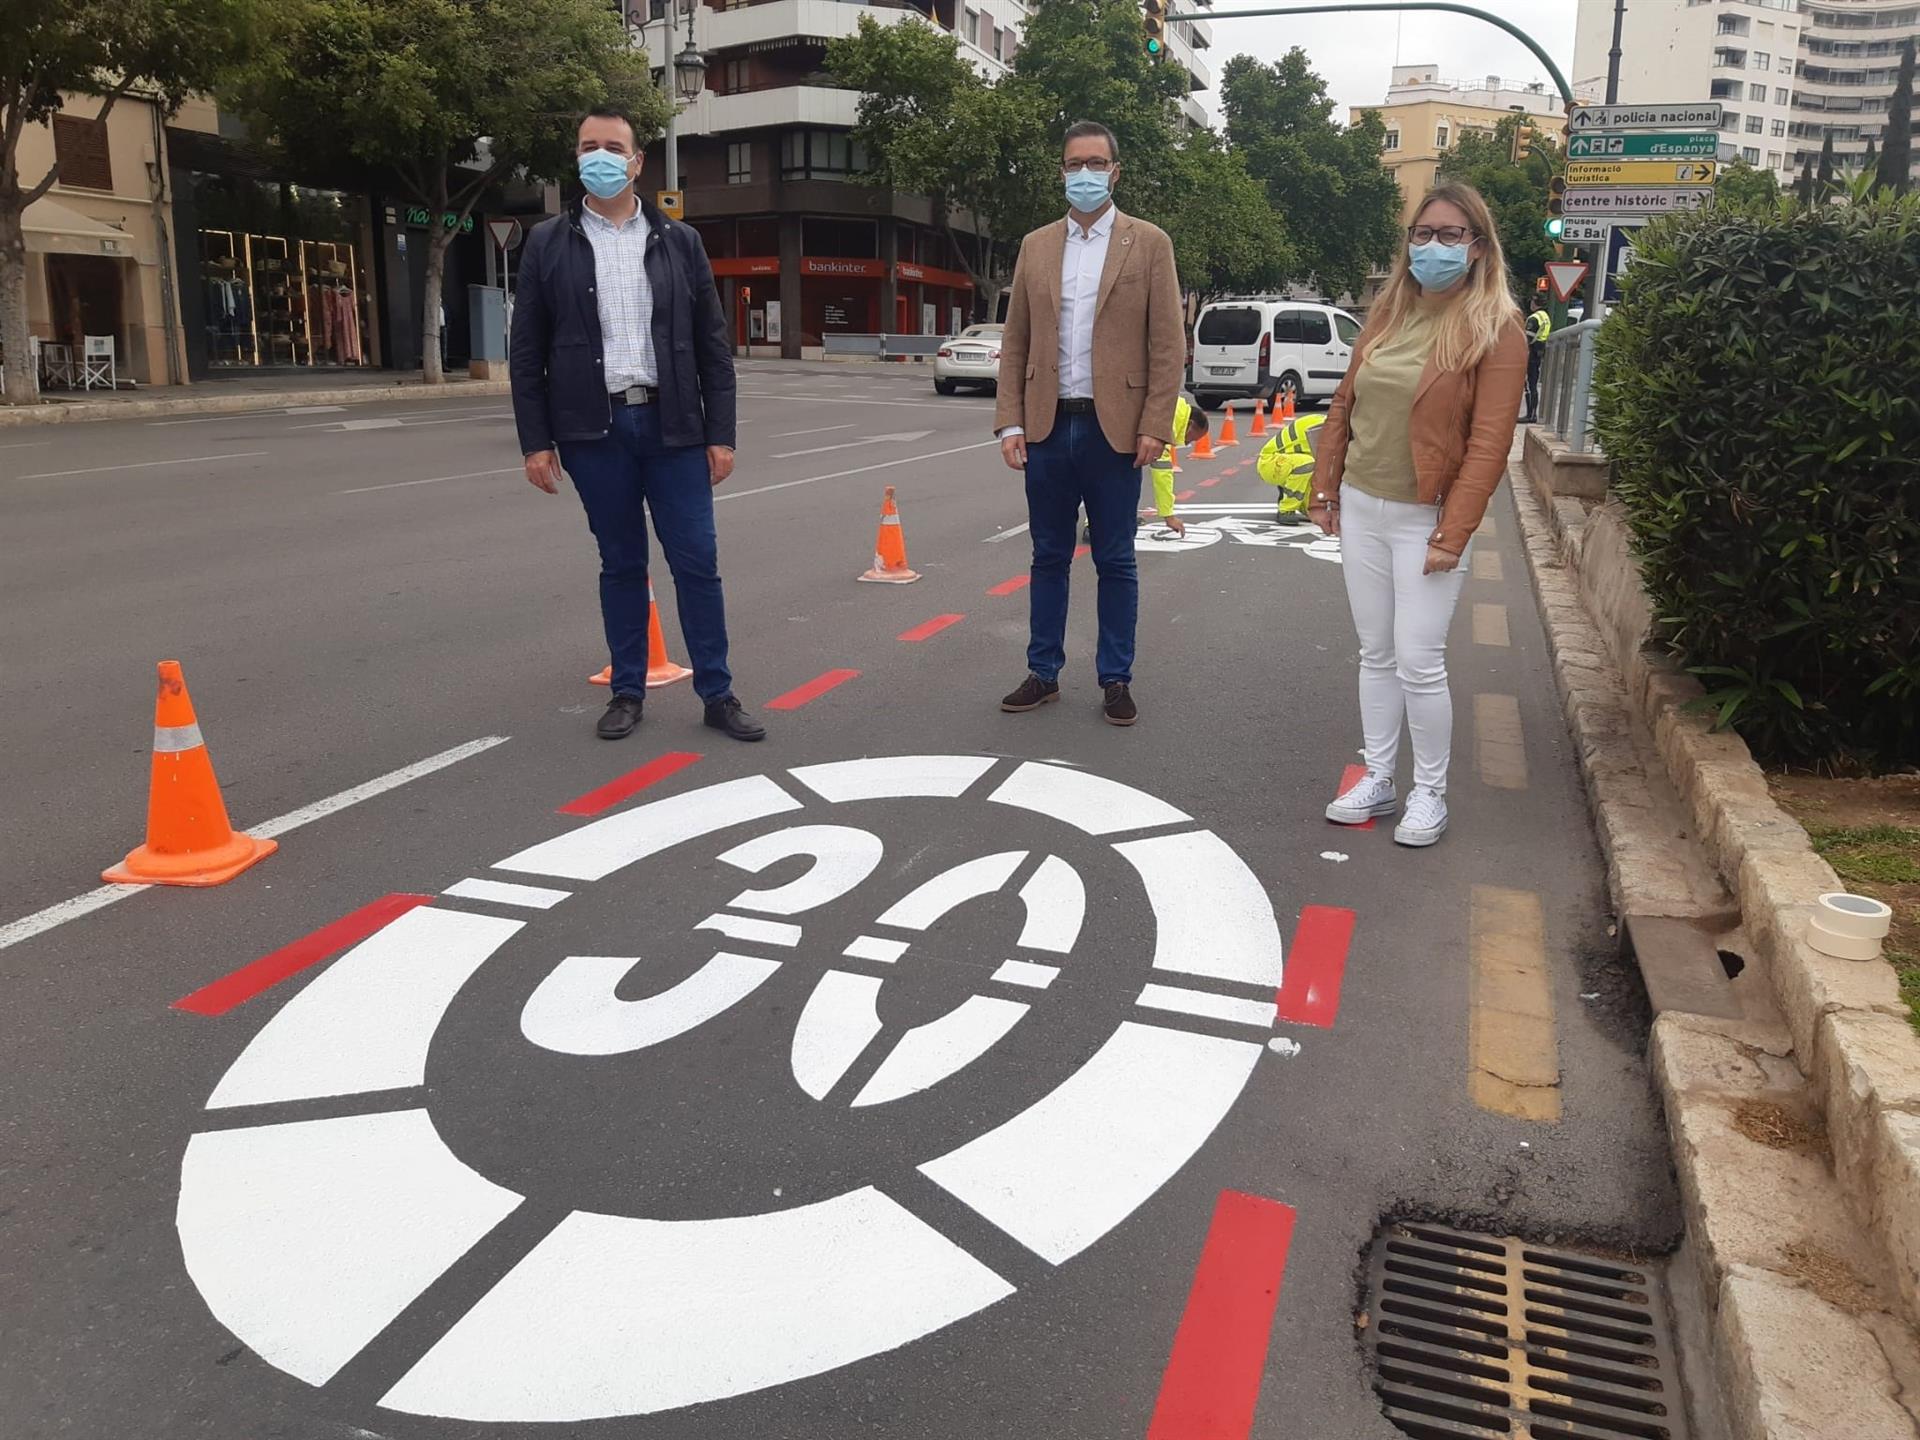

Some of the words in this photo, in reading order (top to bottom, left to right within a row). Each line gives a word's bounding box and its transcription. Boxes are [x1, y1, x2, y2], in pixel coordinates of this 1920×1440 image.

[1613, 111, 1656, 124] policia
[1661, 109, 1717, 122] nacional
[1650, 143, 1715, 155] d'Espanya
[1566, 195, 1609, 206] centre
[1614, 194, 1667, 206] històric
[1565, 218, 1598, 226] museu
[1564, 227, 1580, 239] Es
[519, 824, 1086, 1108] 30
